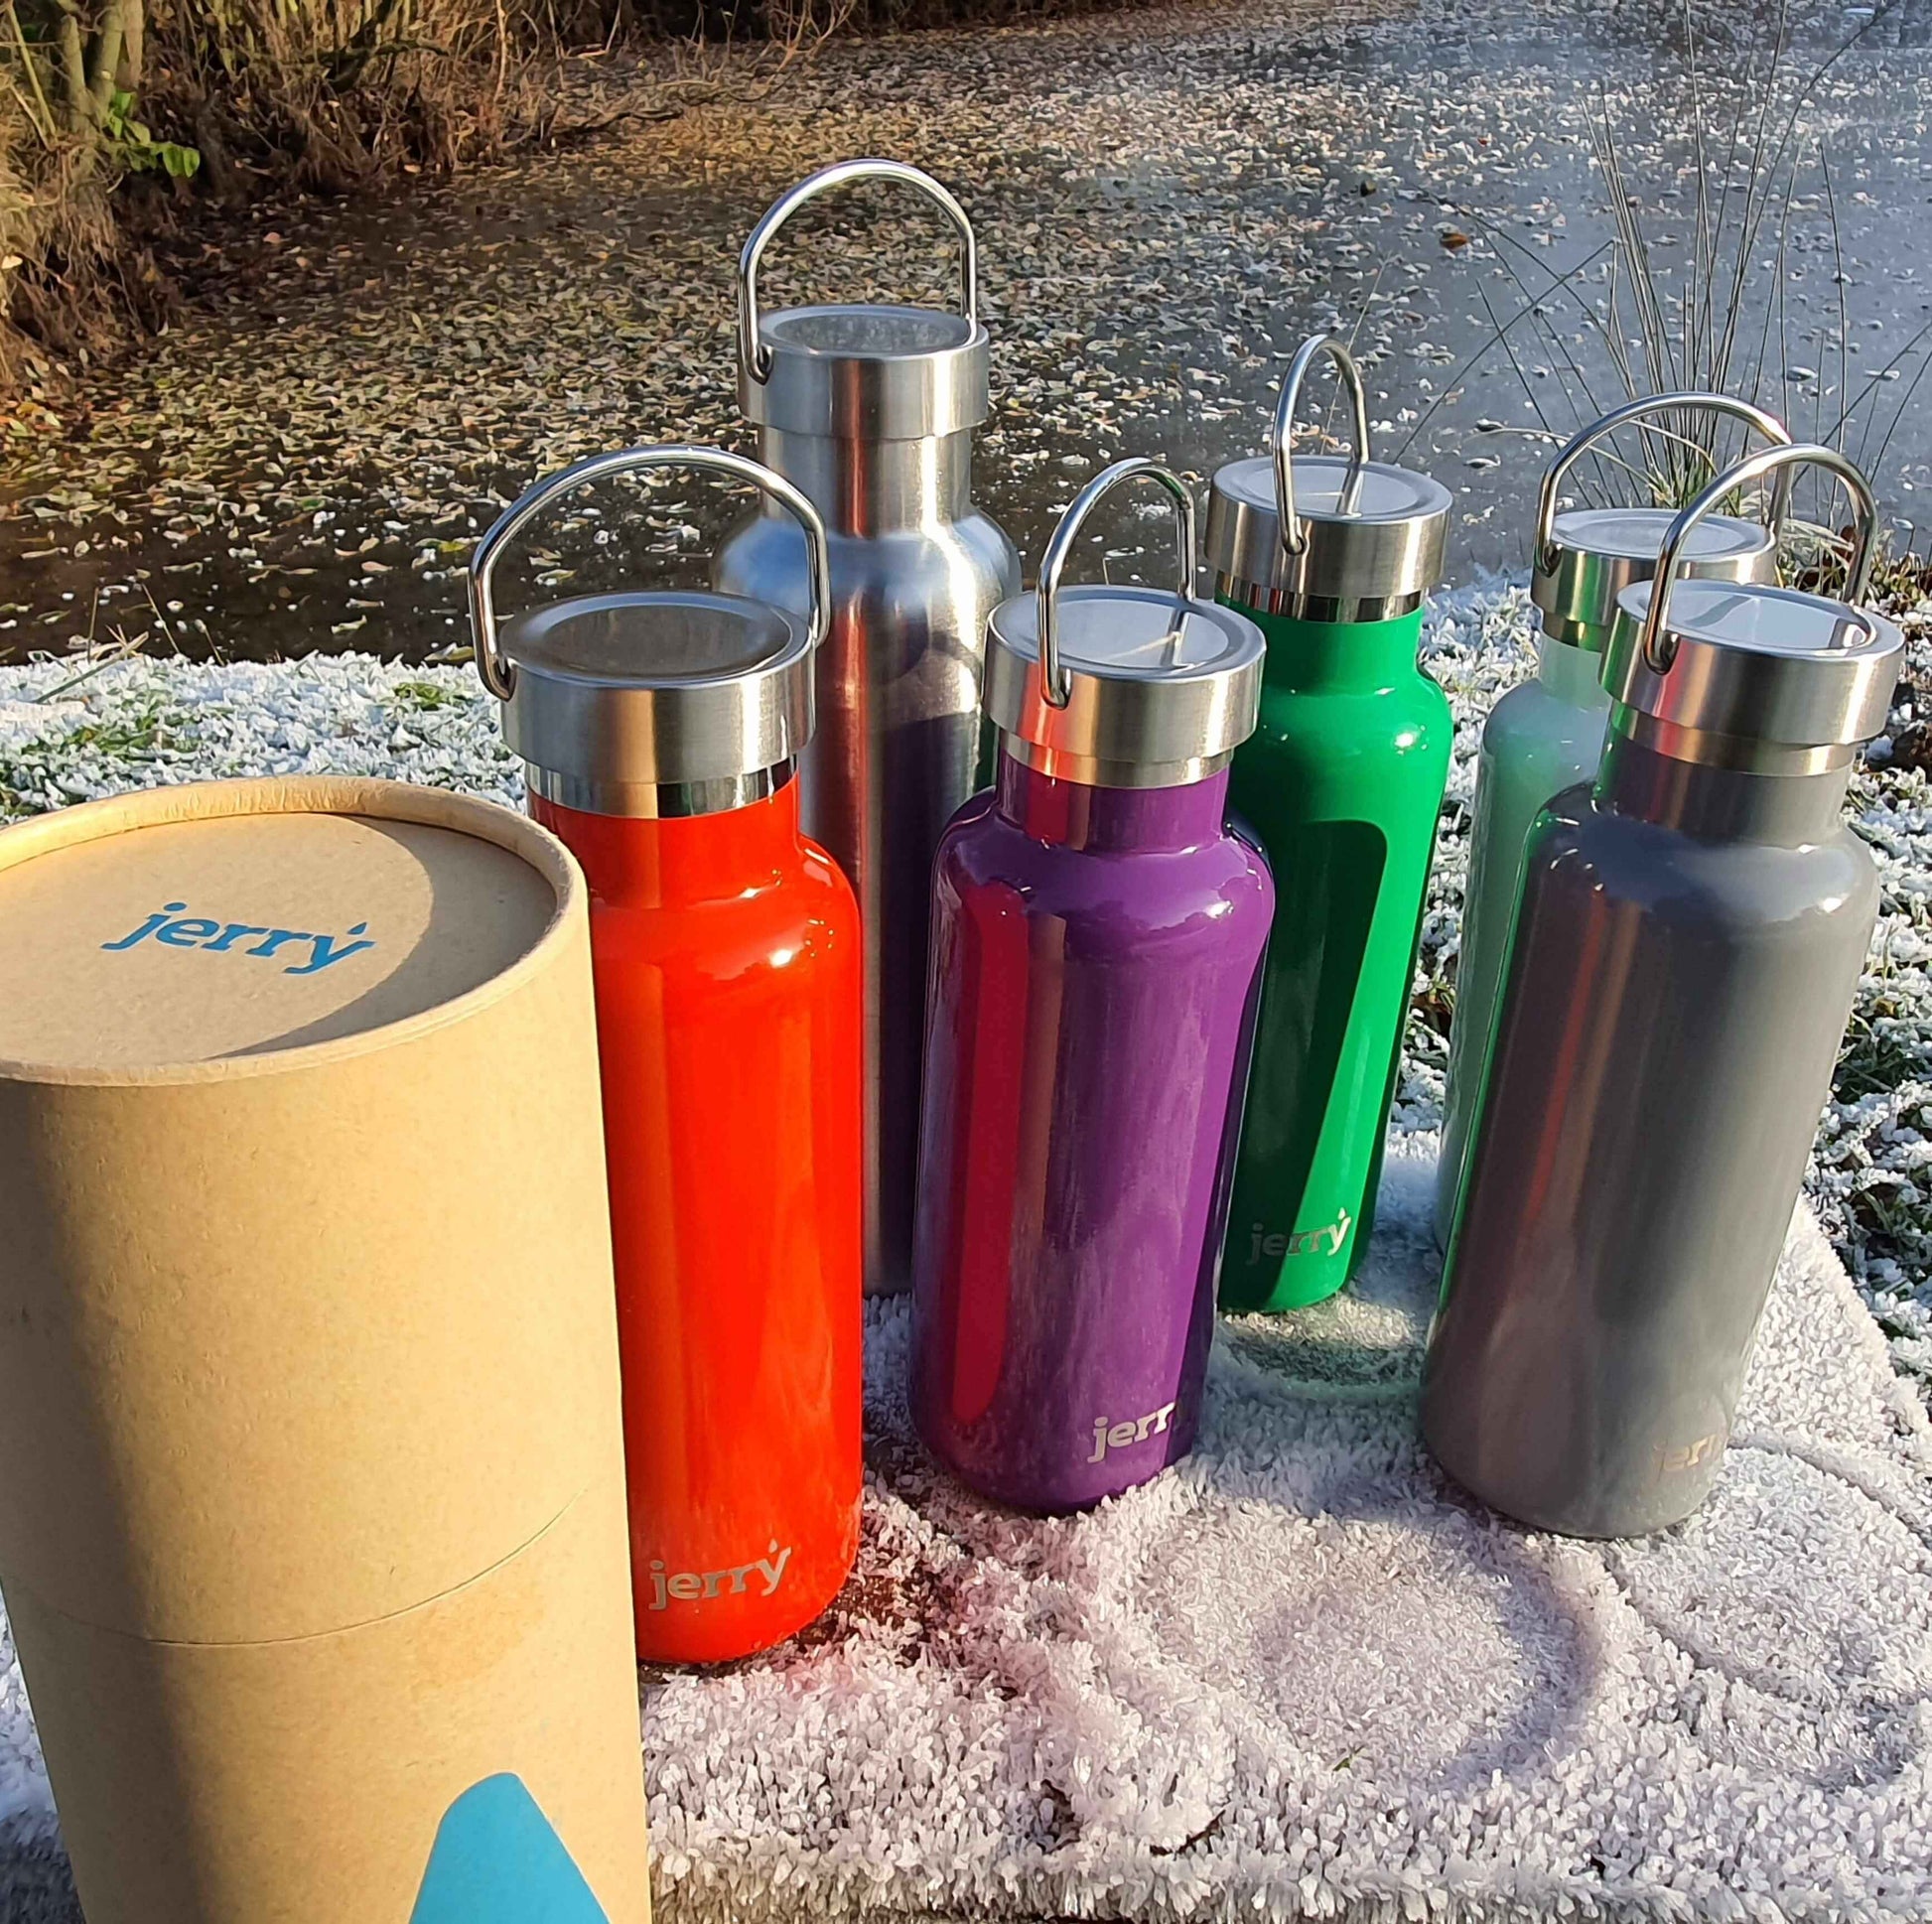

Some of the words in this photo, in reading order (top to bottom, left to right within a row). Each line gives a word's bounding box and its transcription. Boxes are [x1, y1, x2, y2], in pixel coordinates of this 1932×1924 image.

[99, 901, 376, 975] jerry
[1245, 1206, 1351, 1266] jerry
[647, 1538, 792, 1610] jerry
